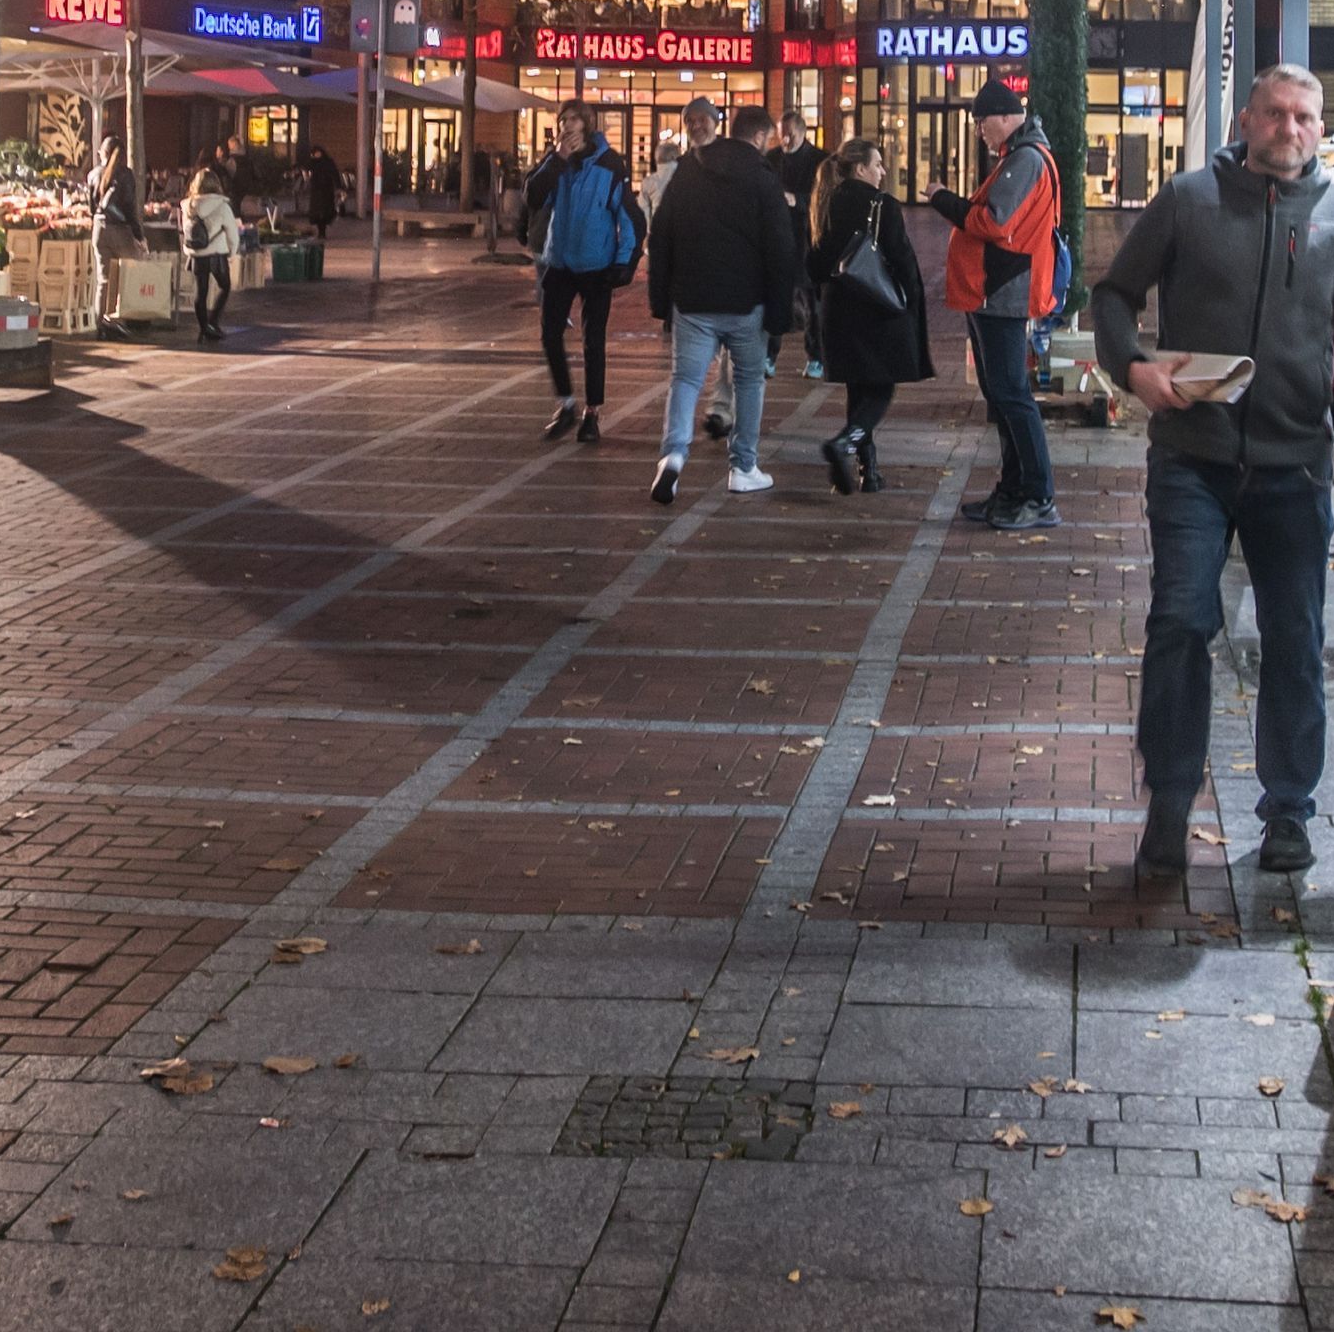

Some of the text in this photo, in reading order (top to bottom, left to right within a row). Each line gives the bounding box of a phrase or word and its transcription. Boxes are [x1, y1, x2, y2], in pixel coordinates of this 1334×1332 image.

[195, 6, 297, 40] Deutsche Bank
[877, 26, 1028, 57] RATHAUS
